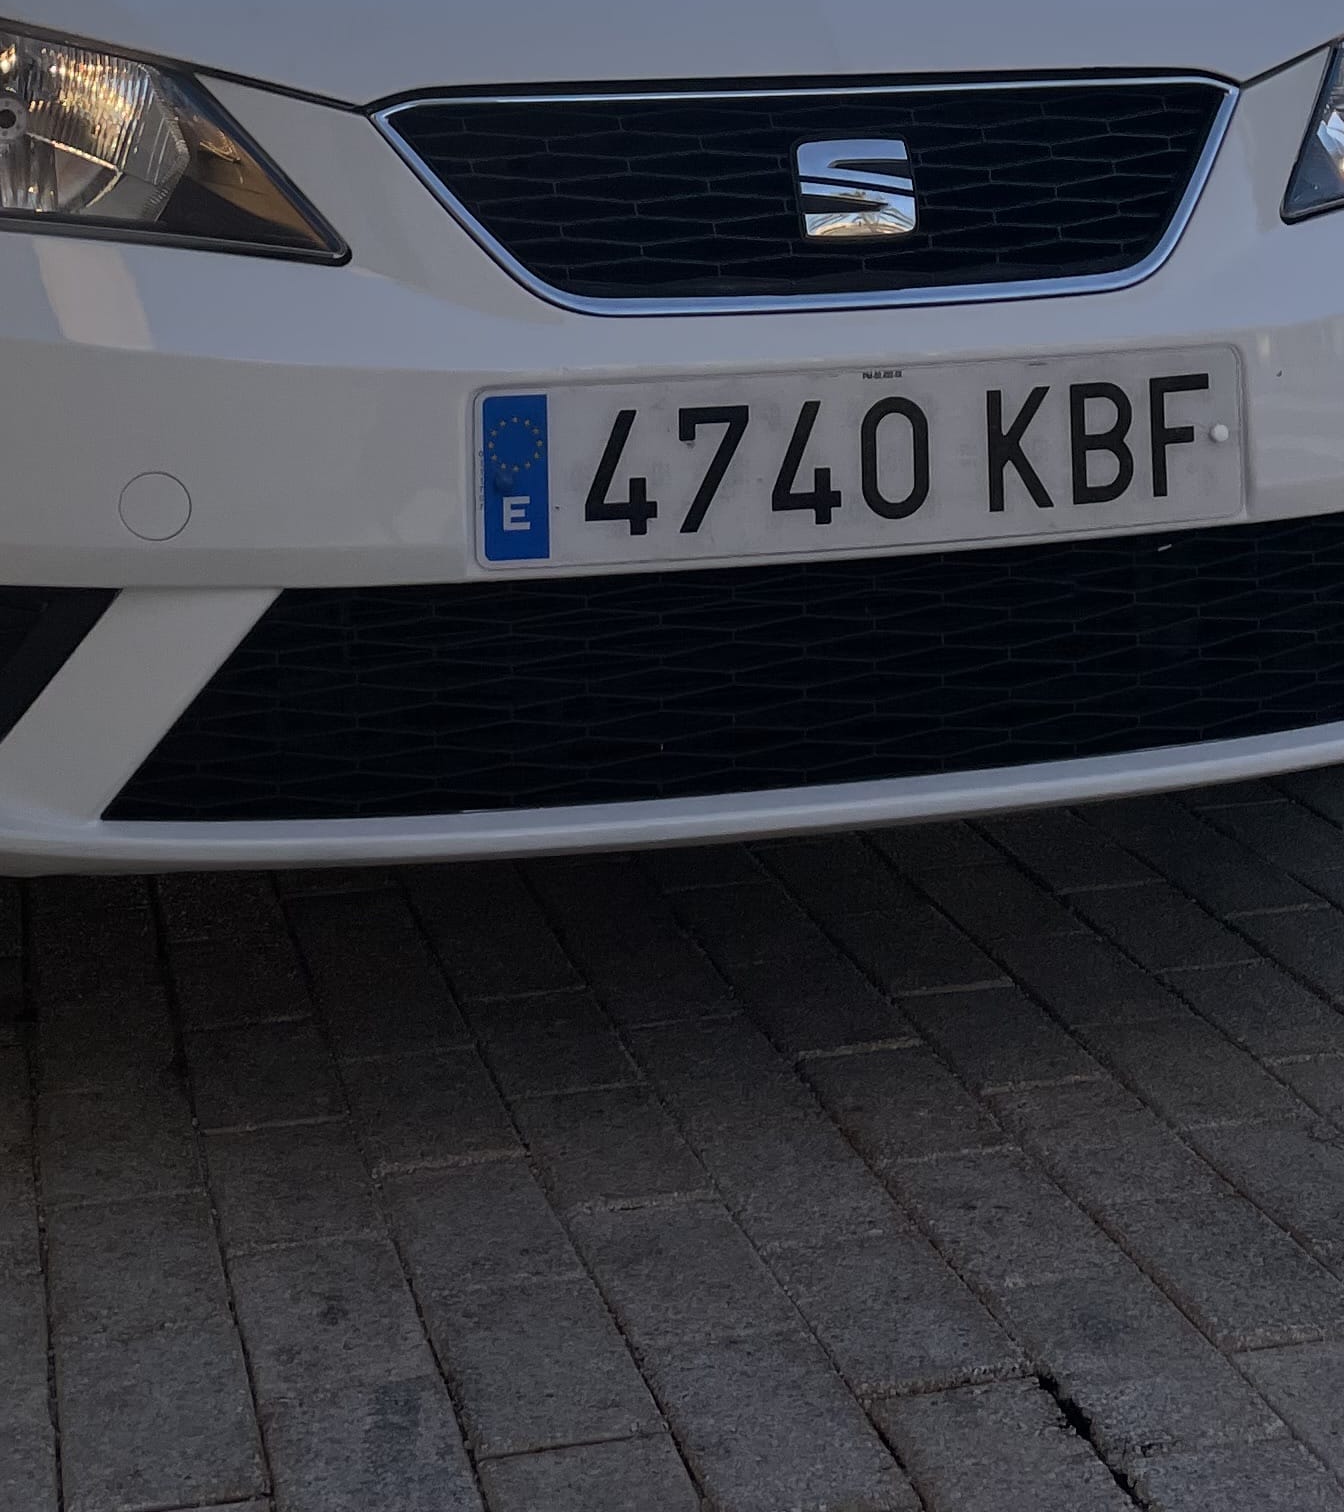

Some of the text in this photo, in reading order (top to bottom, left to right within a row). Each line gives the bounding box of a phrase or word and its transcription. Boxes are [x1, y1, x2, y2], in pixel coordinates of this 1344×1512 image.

[584, 396, 930, 536] 4740
[986, 373, 1210, 513] KBF
[502, 496, 531, 531] E
